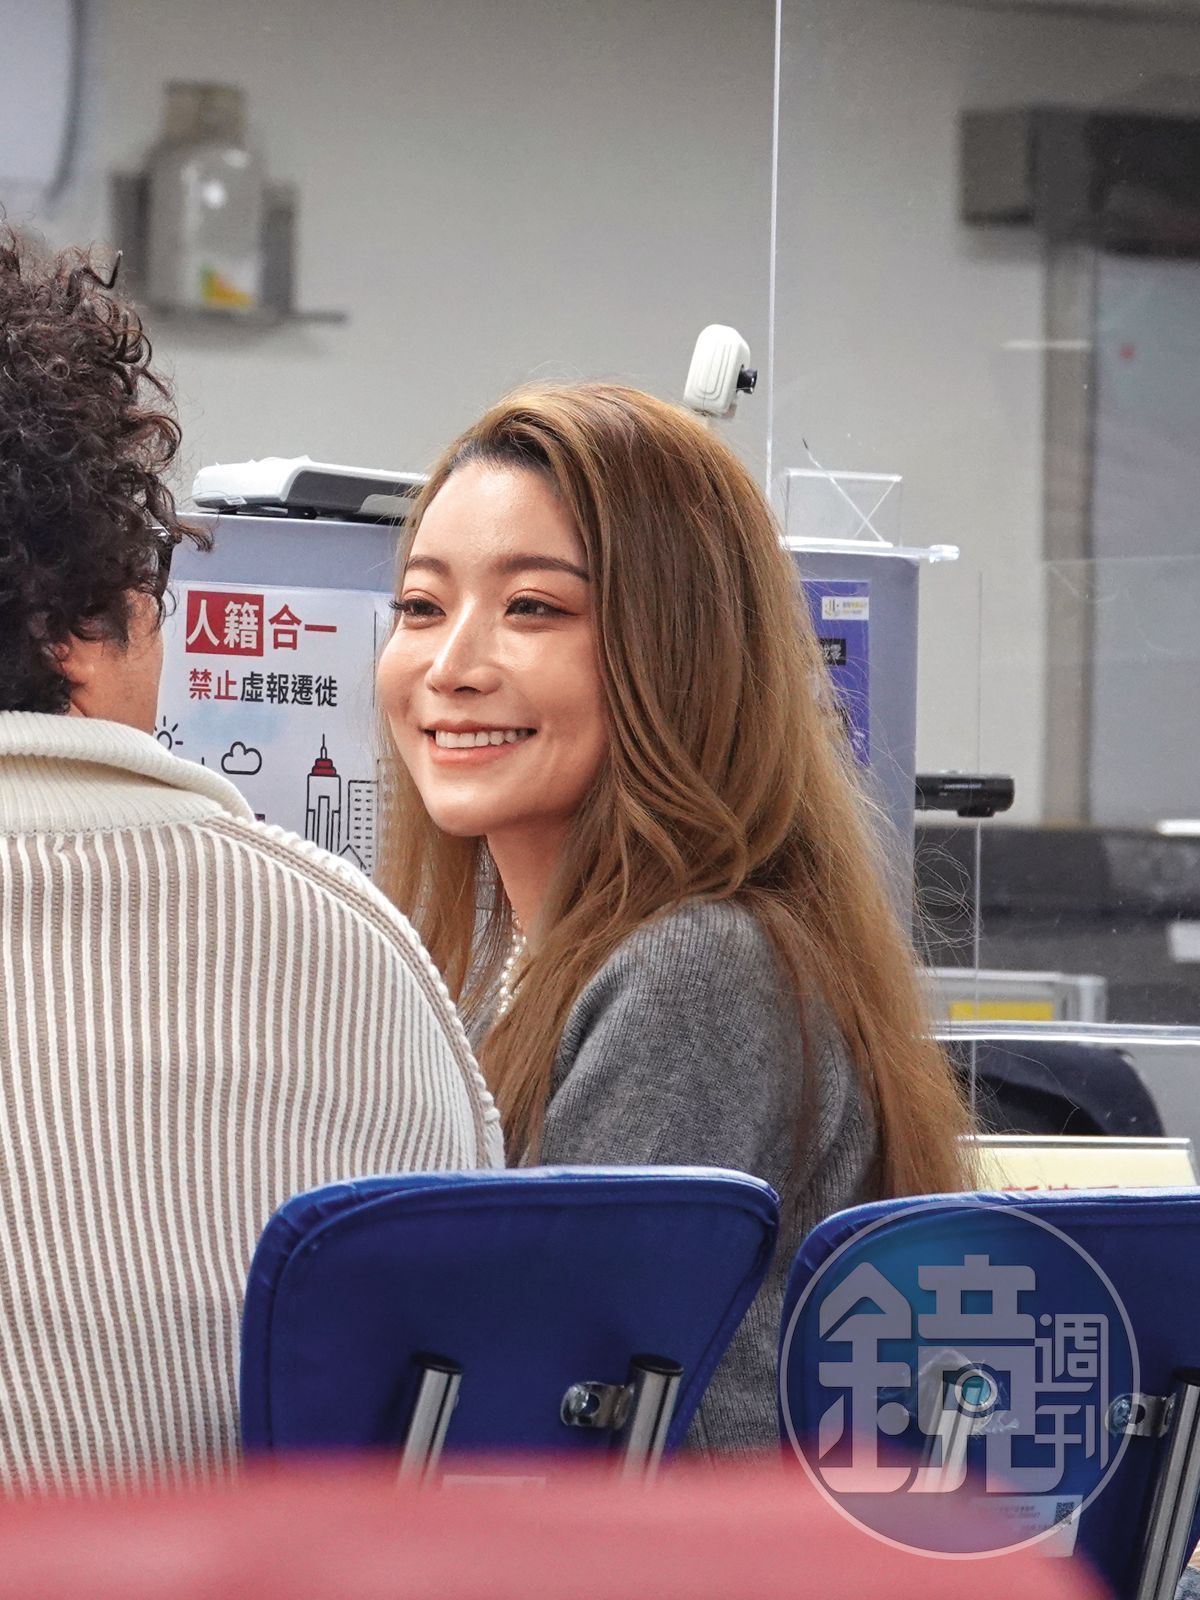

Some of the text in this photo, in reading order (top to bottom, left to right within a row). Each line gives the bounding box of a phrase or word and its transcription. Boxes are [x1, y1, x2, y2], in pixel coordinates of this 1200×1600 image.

[186, 597, 338, 651] 人籍合一
[188, 667, 338, 707] 禁止虛報遷徙
